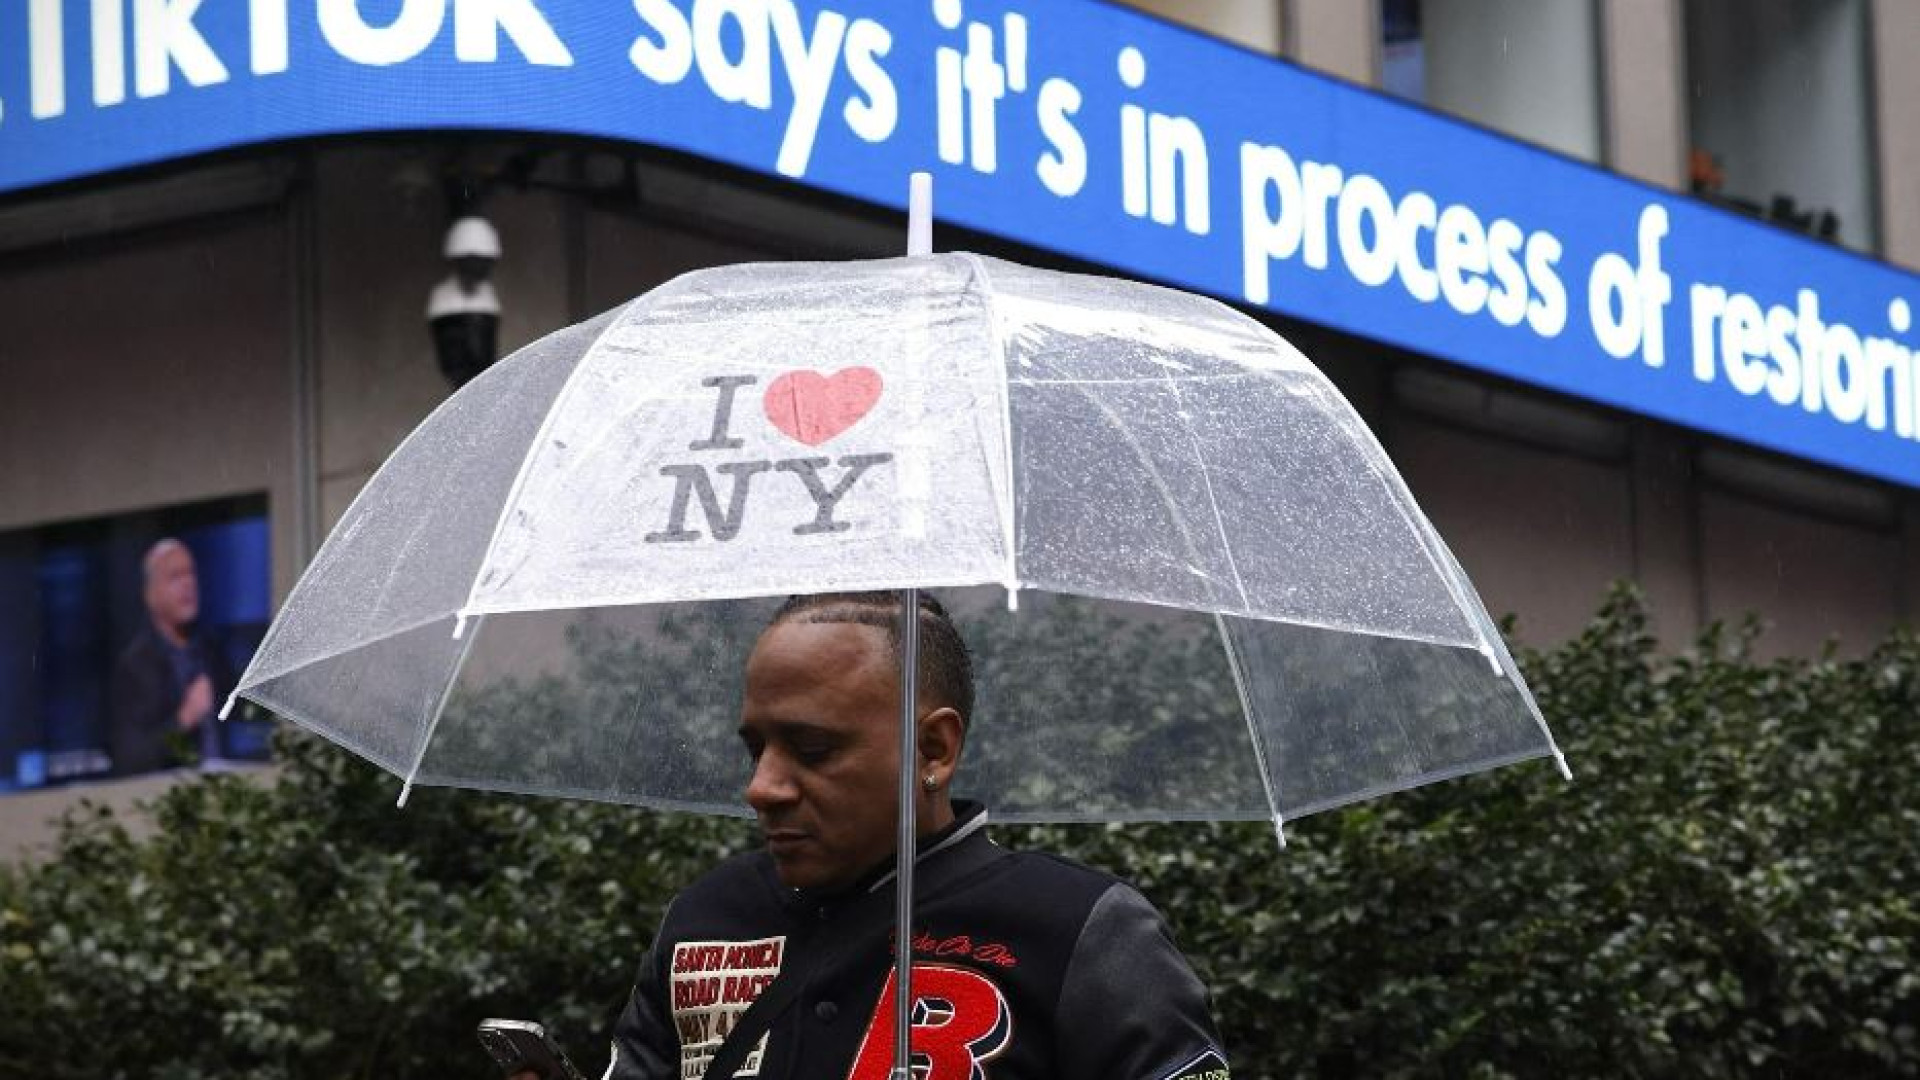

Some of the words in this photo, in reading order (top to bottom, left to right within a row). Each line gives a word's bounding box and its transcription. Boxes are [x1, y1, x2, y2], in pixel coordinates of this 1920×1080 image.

[630, 0, 898, 177] says
[934, 0, 1087, 197] it's
[1118, 47, 1210, 235] in
[1240, 141, 1567, 337] process
[1589, 204, 1671, 367] of
[1690, 283, 1920, 442] restori
[689, 375, 757, 450] I
[645, 452, 893, 543] NY
[674, 945, 724, 973] SANTA
[724, 941, 781, 970] MONICA
[674, 977, 721, 1011] ROAD
